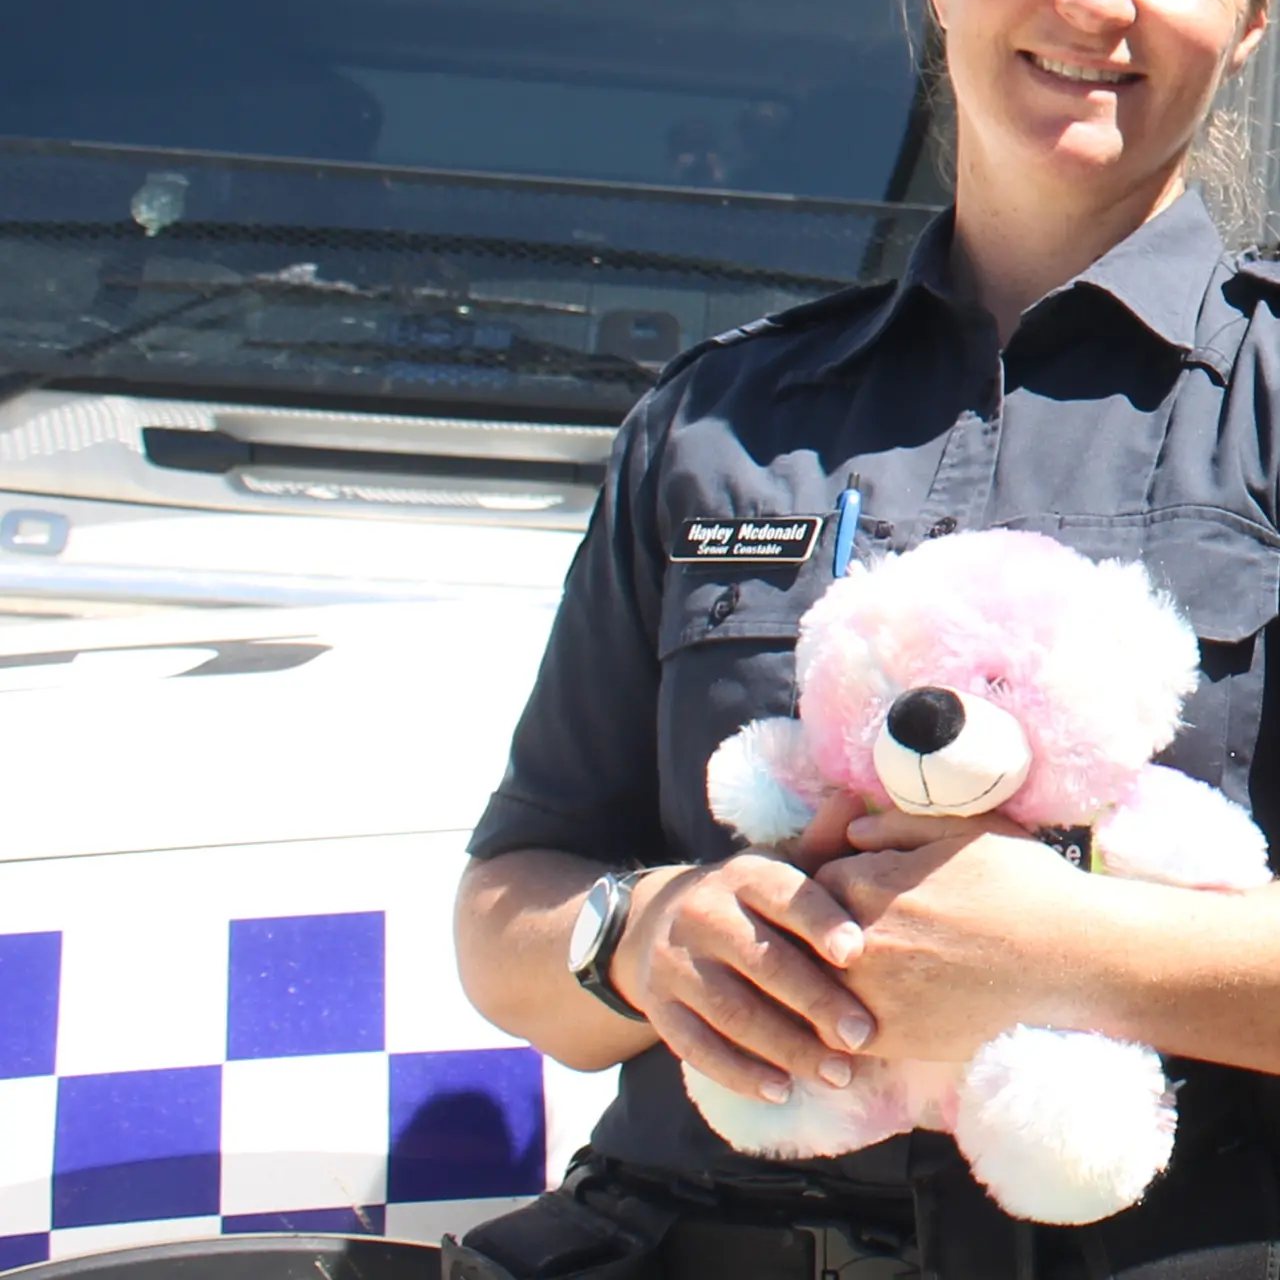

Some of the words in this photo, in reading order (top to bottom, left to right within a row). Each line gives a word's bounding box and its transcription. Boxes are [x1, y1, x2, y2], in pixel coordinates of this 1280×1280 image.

[688, 524, 734, 544] Hayley
[738, 523, 807, 540] Mcdonald
[697, 543, 729, 555] Senior
[733, 543, 782, 555] Constable
